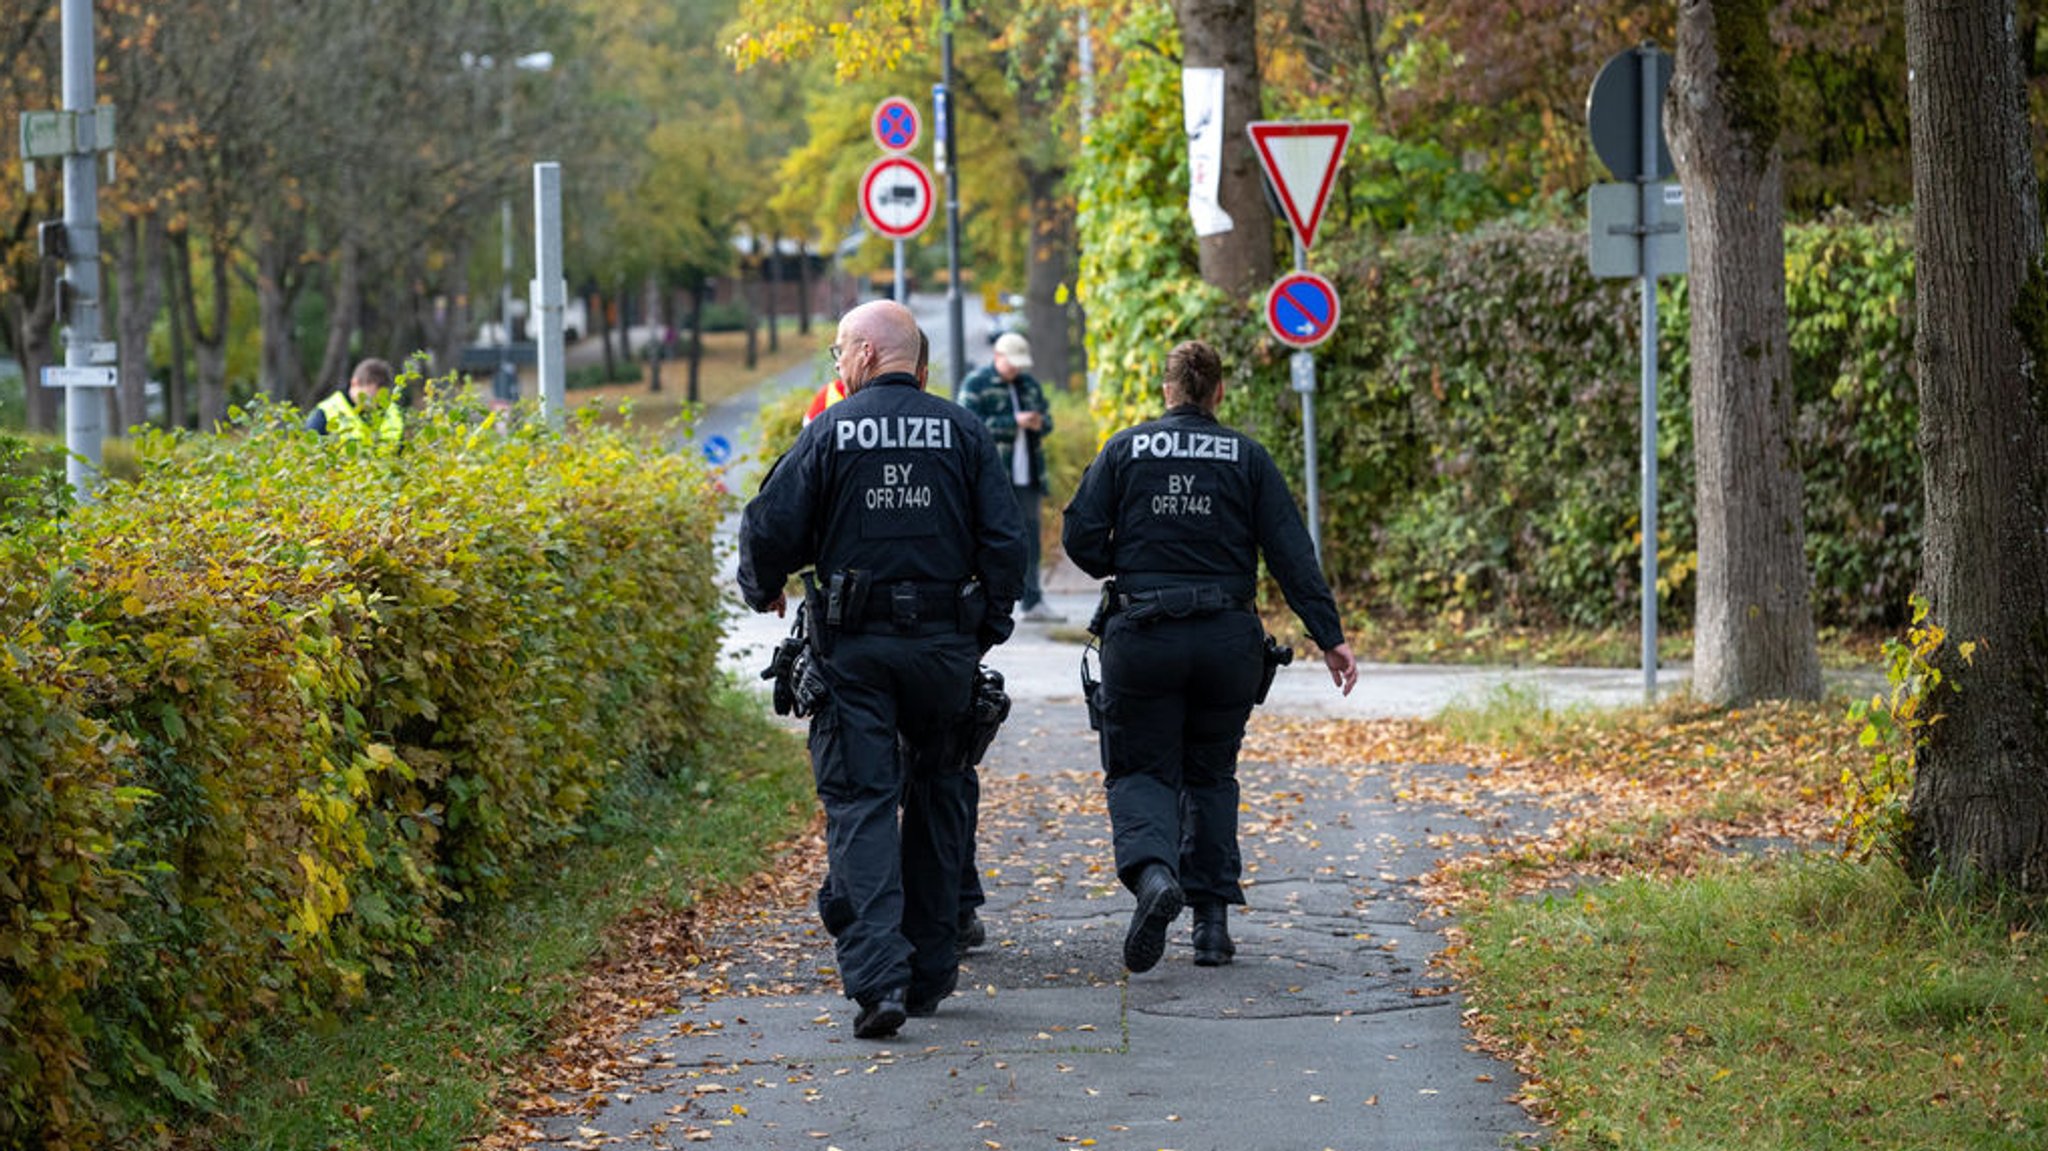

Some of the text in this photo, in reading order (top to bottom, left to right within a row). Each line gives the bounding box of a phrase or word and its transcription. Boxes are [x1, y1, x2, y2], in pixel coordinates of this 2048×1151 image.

[836, 417, 952, 450] POLIZEI
[1131, 431, 1239, 462] POLIZEI
[883, 463, 913, 486] BY
[1168, 474, 1196, 495] BY
[865, 486, 932, 510] OFR 7440
[1151, 495, 1212, 516] OFR 7442
